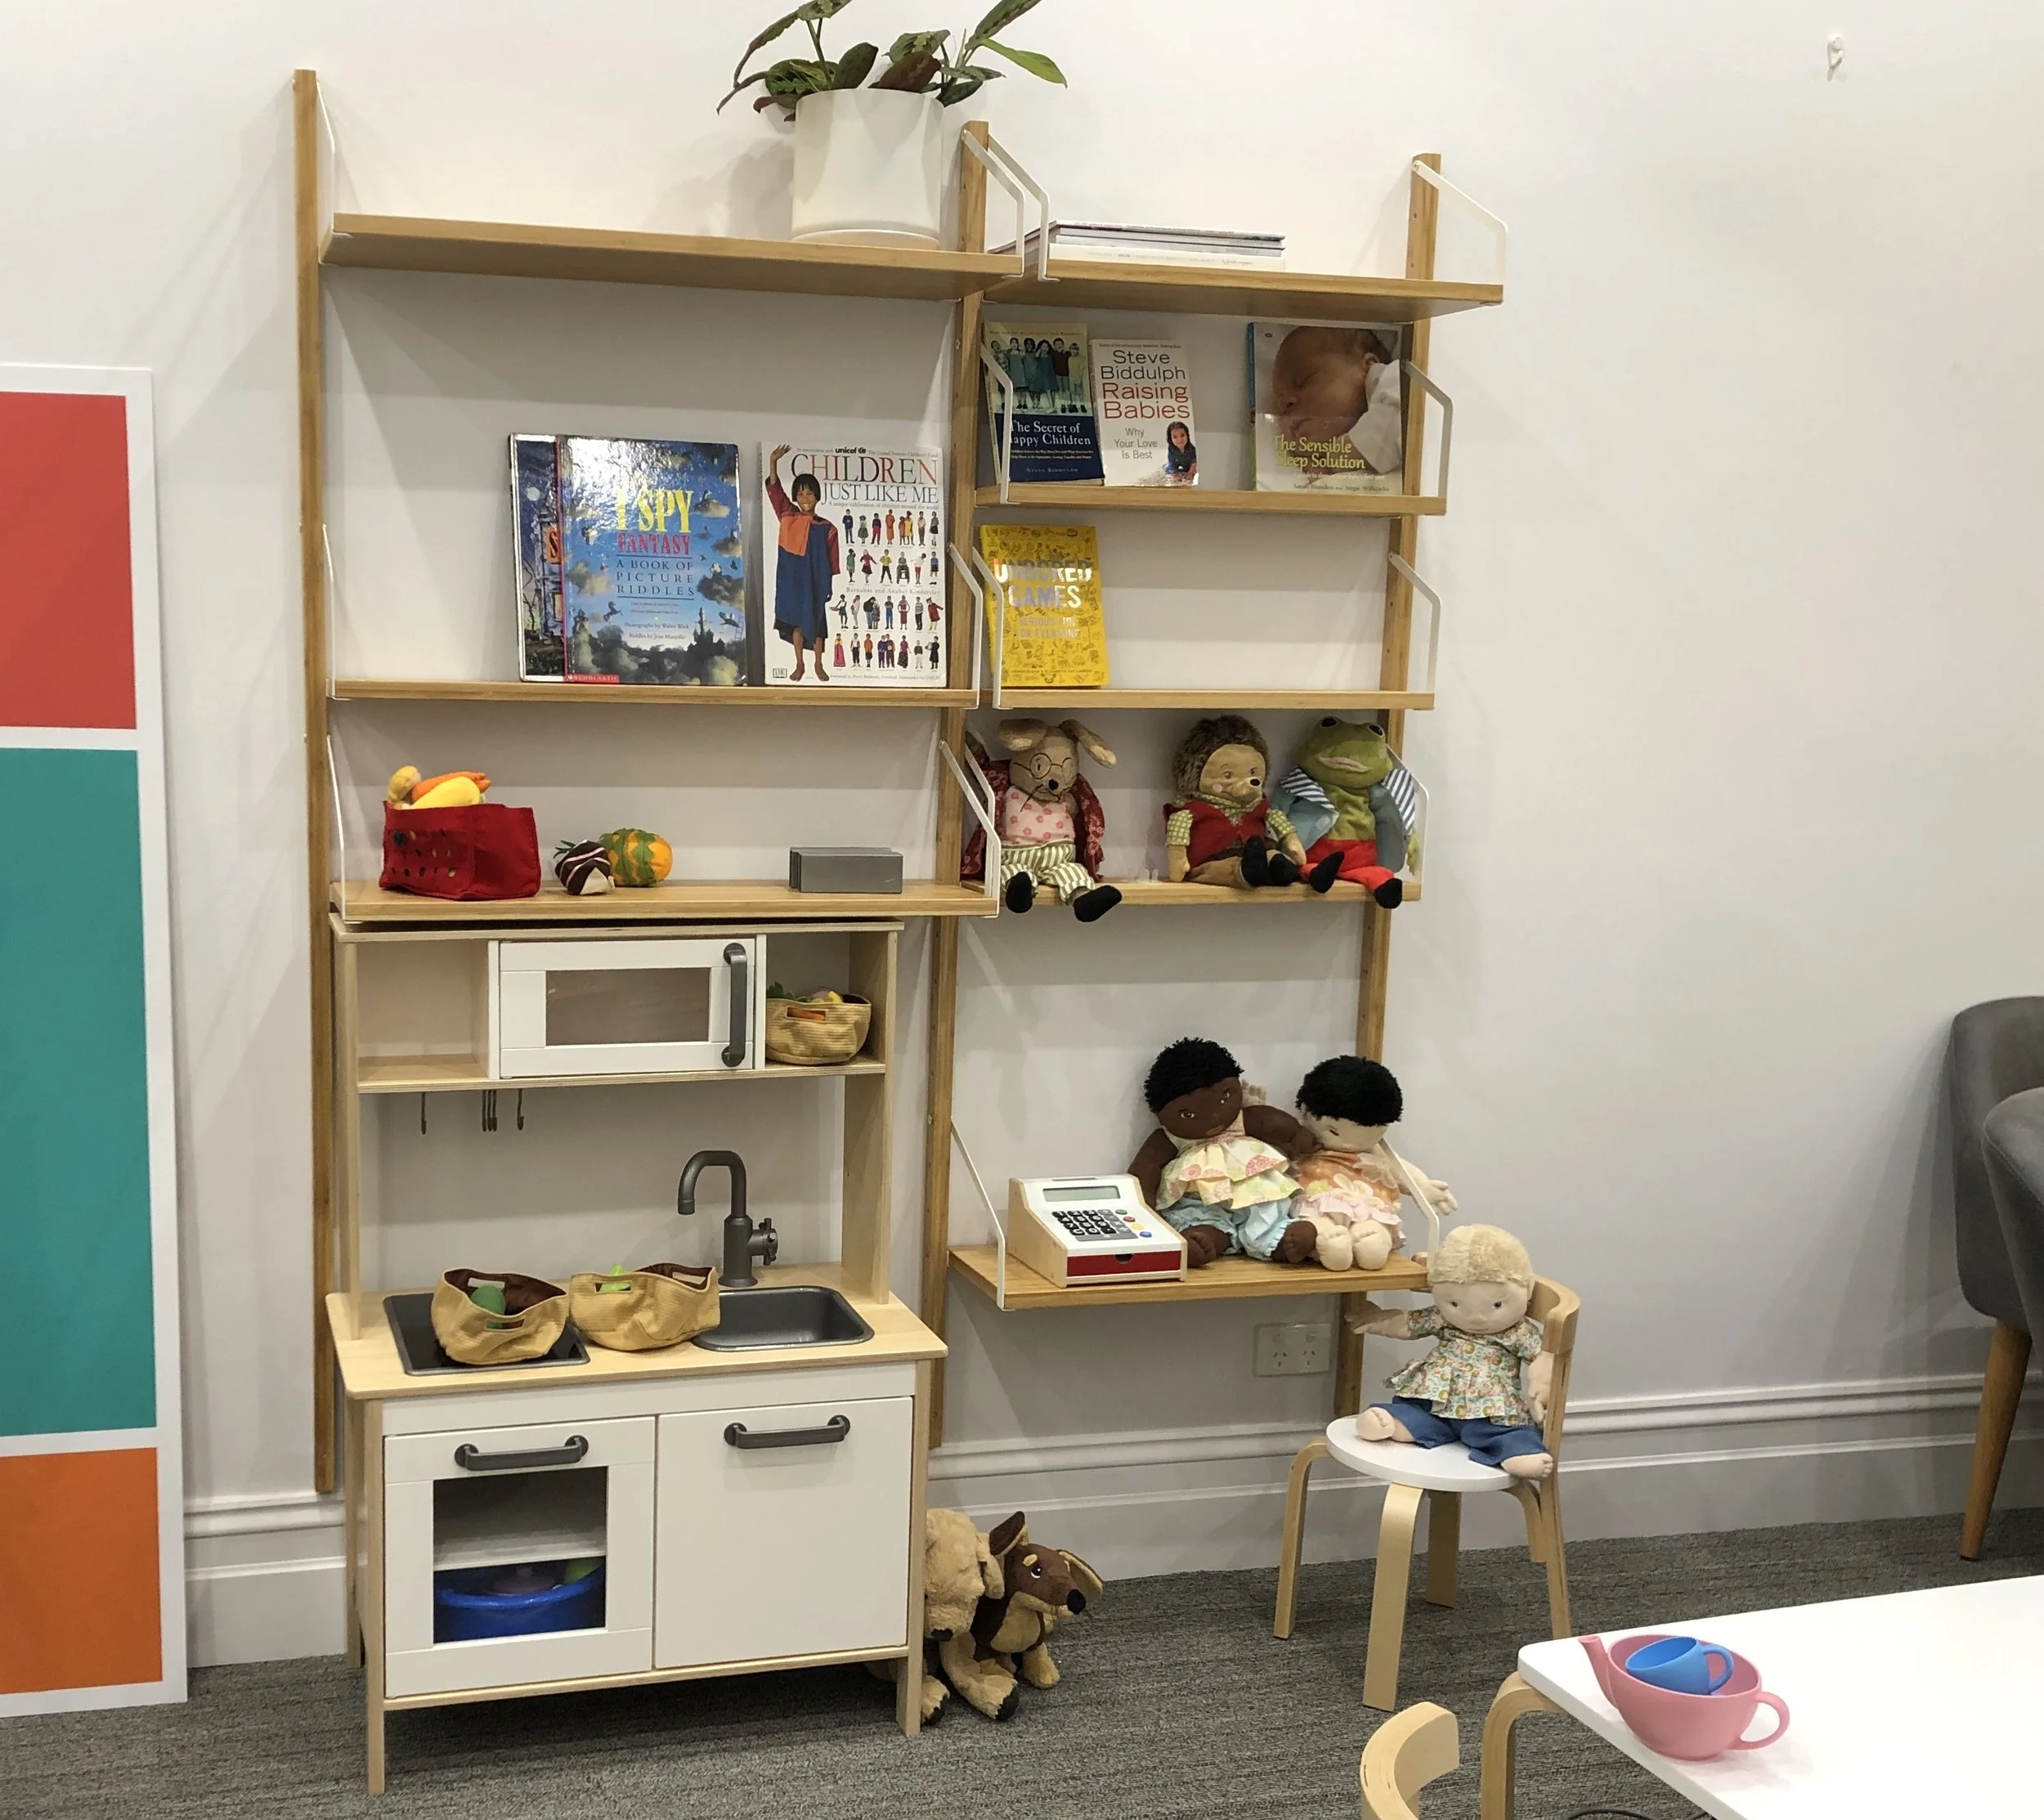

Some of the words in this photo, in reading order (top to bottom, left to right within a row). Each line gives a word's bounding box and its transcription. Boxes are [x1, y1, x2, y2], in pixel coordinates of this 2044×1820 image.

[1113, 349, 1170, 365] Steve
[1100, 365, 1186, 383] Biddulph
[1102, 382, 1189, 403] Raising
[1104, 401, 1190, 419] Babies
[1033, 420, 1067, 433] Secret
[1069, 423, 1081, 433] of
[1125, 428, 1145, 437] Why
[1010, 436, 1039, 446] appy
[1042, 433, 1091, 445] Children
[1114, 439, 1134, 448] Your
[1137, 439, 1159, 448] Love
[1273, 434, 1296, 451] The
[1299, 437, 1352, 453] Sensible
[1122, 451, 1130, 459] Is
[1132, 451, 1153, 459] Best
[1276, 451, 1308, 470] Sleep
[1311, 453, 1365, 469] Solution
[791, 453, 939, 486] CHILDREN
[821, 483, 861, 504] JUST
[865, 484, 907, 502] LIKE
[912, 486, 939, 504] ME
[616, 489, 628, 531] I
[637, 487, 694, 533] SPY
[617, 532, 691, 555] FANTASY
[616, 558, 625, 569] A
[630, 559, 670, 571] BOOK
[675, 561, 694, 572] OF
[616, 572, 694, 584] PICTURE
[616, 585, 695, 597] RIDDLES
[1008, 585, 1082, 608] GAMES
